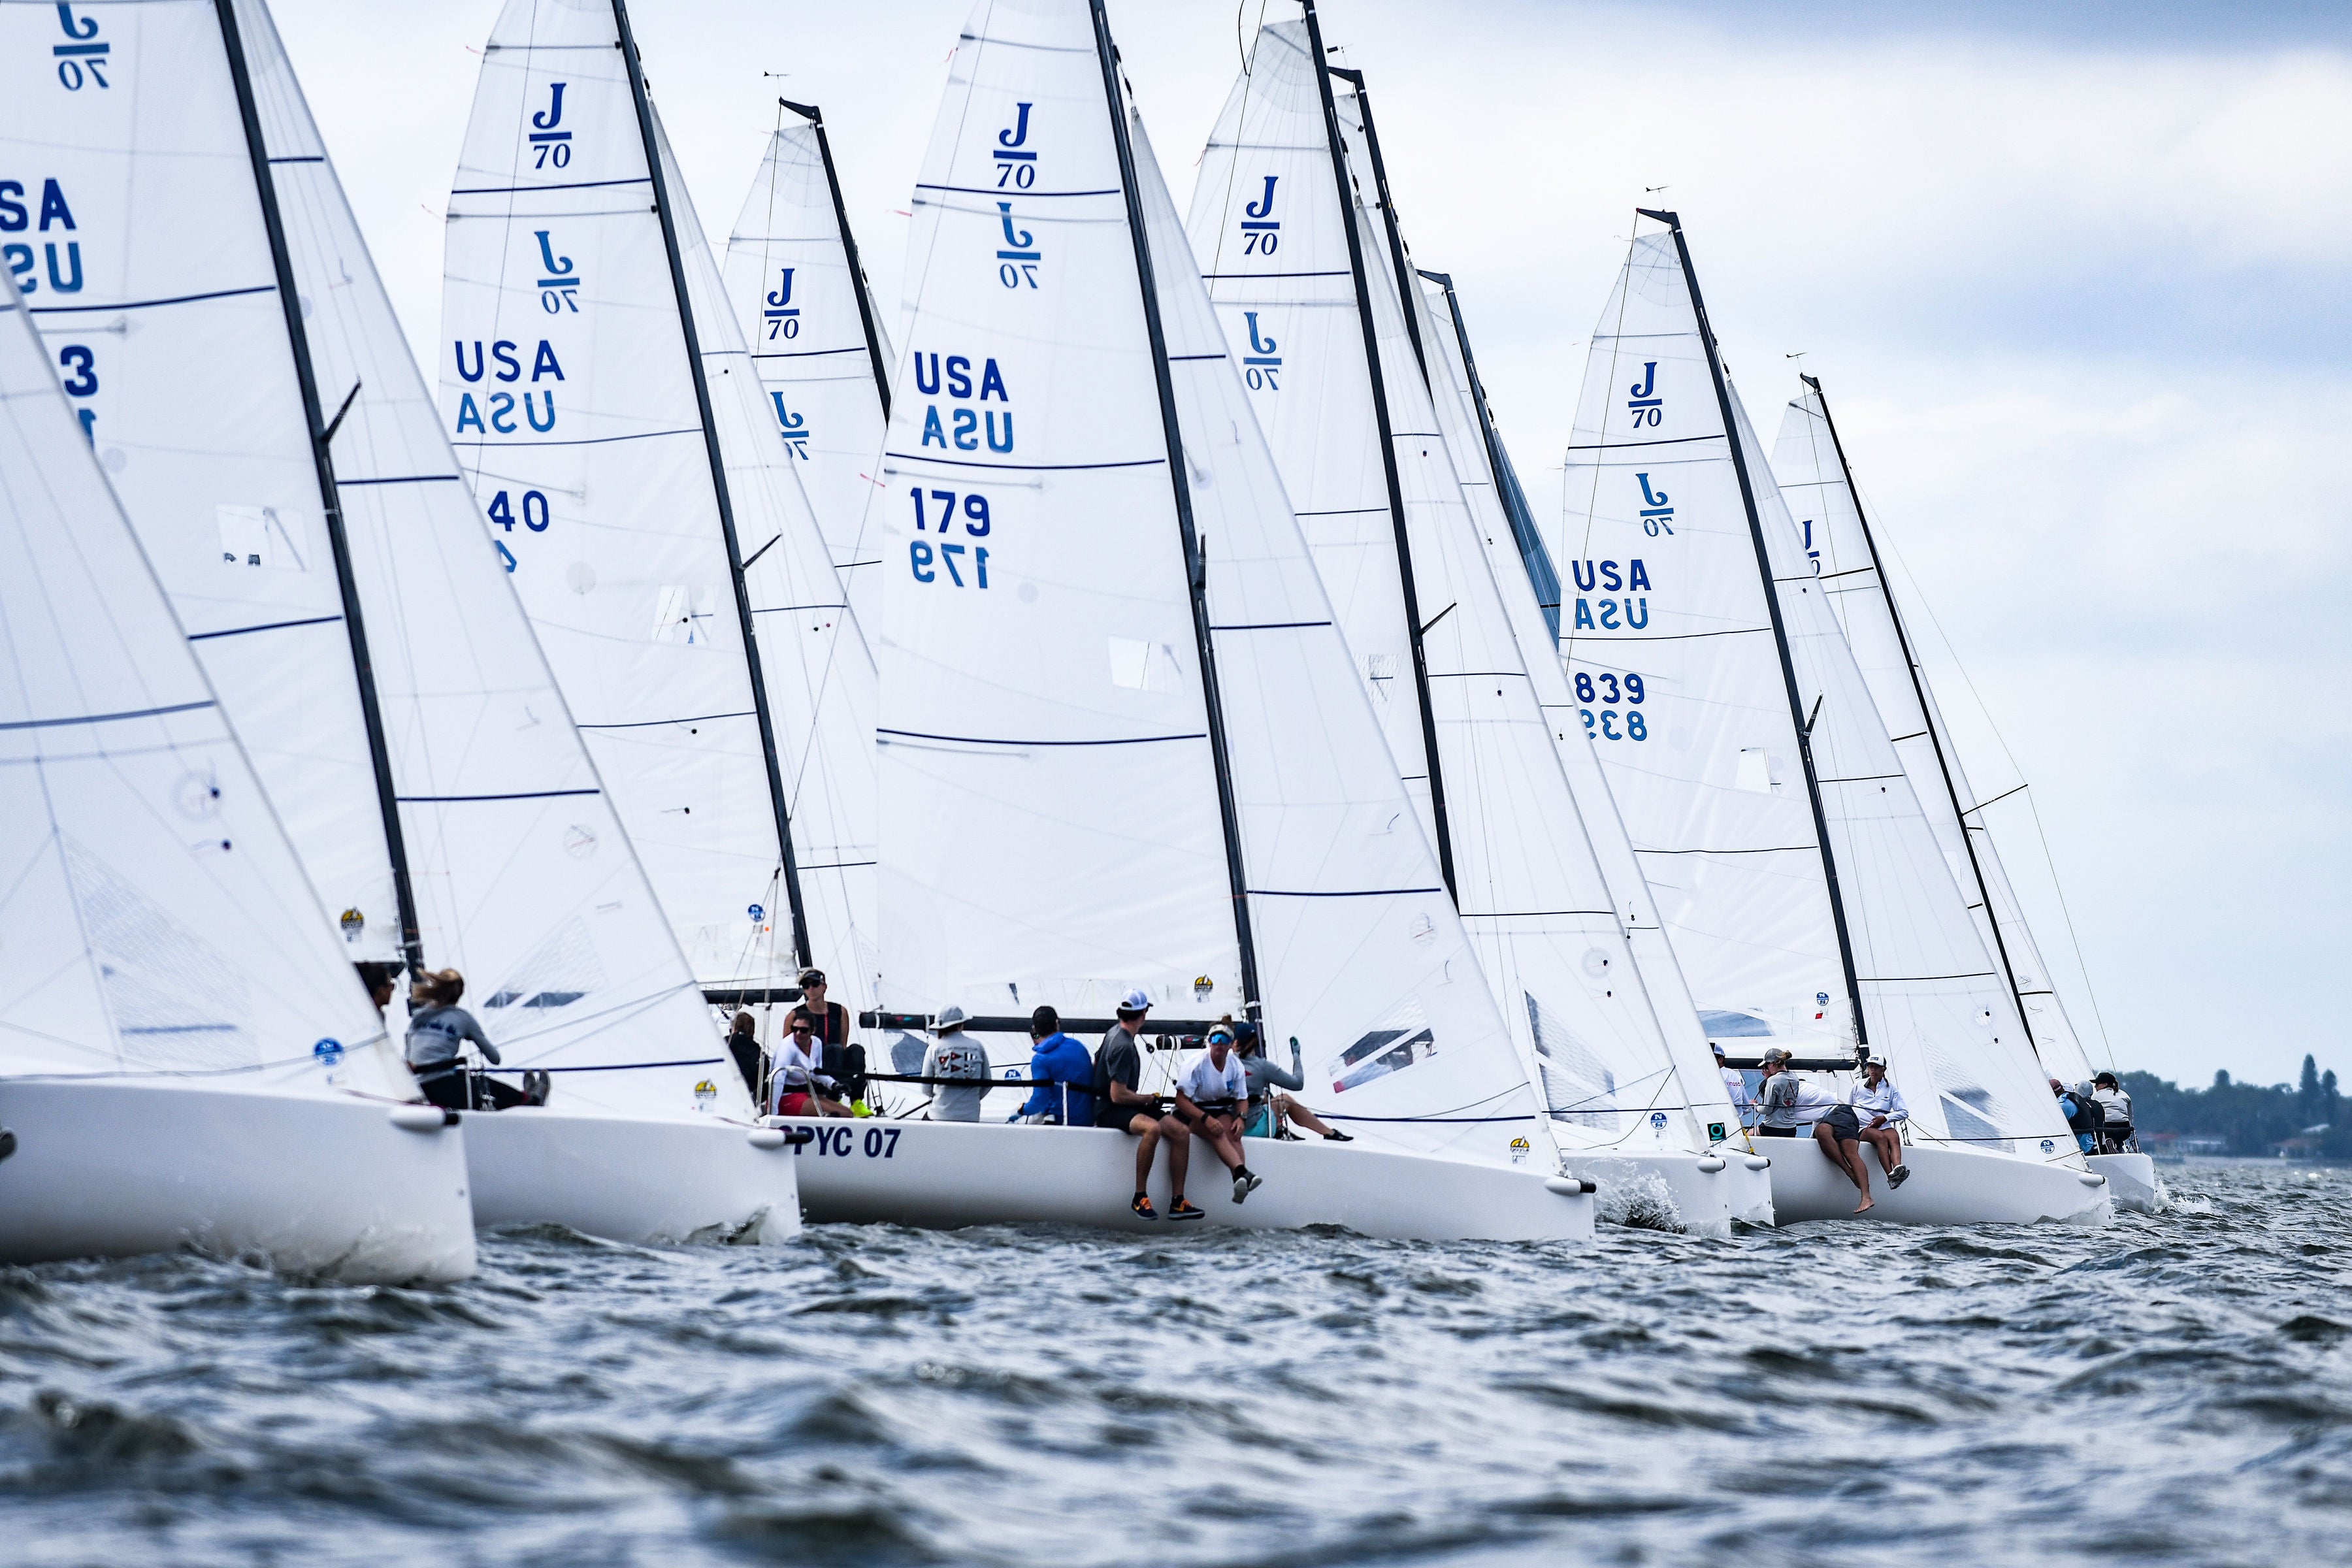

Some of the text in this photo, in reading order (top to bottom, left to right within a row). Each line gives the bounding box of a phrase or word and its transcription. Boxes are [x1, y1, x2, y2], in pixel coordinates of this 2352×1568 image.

[533, 83, 566, 129] J
[999, 103, 1032, 147] J
[534, 144, 570, 169] 70
[997, 164, 1034, 188] 70
[0, 178, 76, 232] SA
[1246, 176, 1279, 218] J
[1245, 233, 1277, 255] 70
[767, 269, 794, 306] J
[769, 319, 798, 340] 70
[60, 345, 98, 397] 3
[455, 340, 564, 382] USA
[915, 351, 1008, 402] USA
[1631, 362, 1657, 398] J
[1633, 408, 1661, 428] 70
[487, 491, 549, 532] 40
[911, 487, 990, 536] 179
[1572, 559, 1651, 591] USA
[1575, 672, 1644, 704] 839
[779, 1125, 901, 1158] PYC 07
